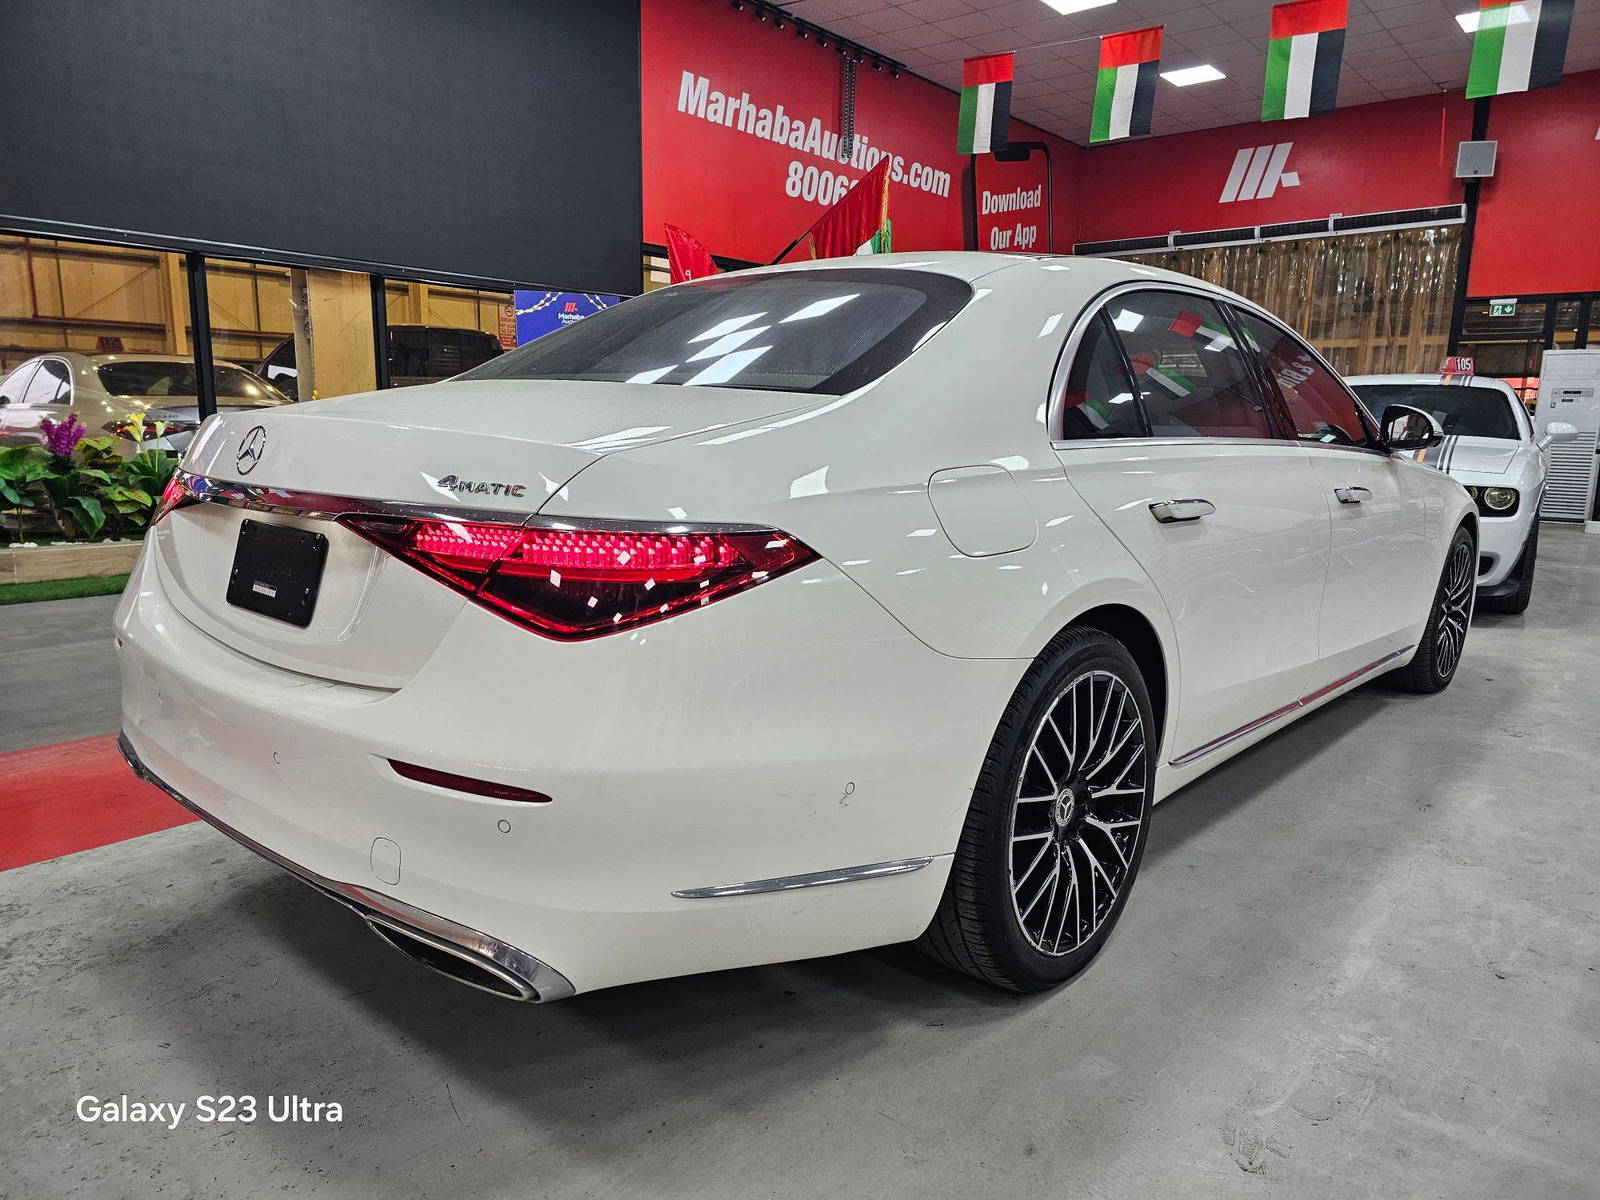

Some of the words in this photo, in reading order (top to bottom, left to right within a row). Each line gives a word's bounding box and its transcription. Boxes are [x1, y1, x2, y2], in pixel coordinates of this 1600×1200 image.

[785, 160, 860, 207] 8006
[981, 184, 1042, 216] Download
[990, 226, 1013, 251] Our
[1013, 222, 1038, 250] App
[1456, 357, 1472, 371] 105
[437, 474, 528, 498] 4MATIC
